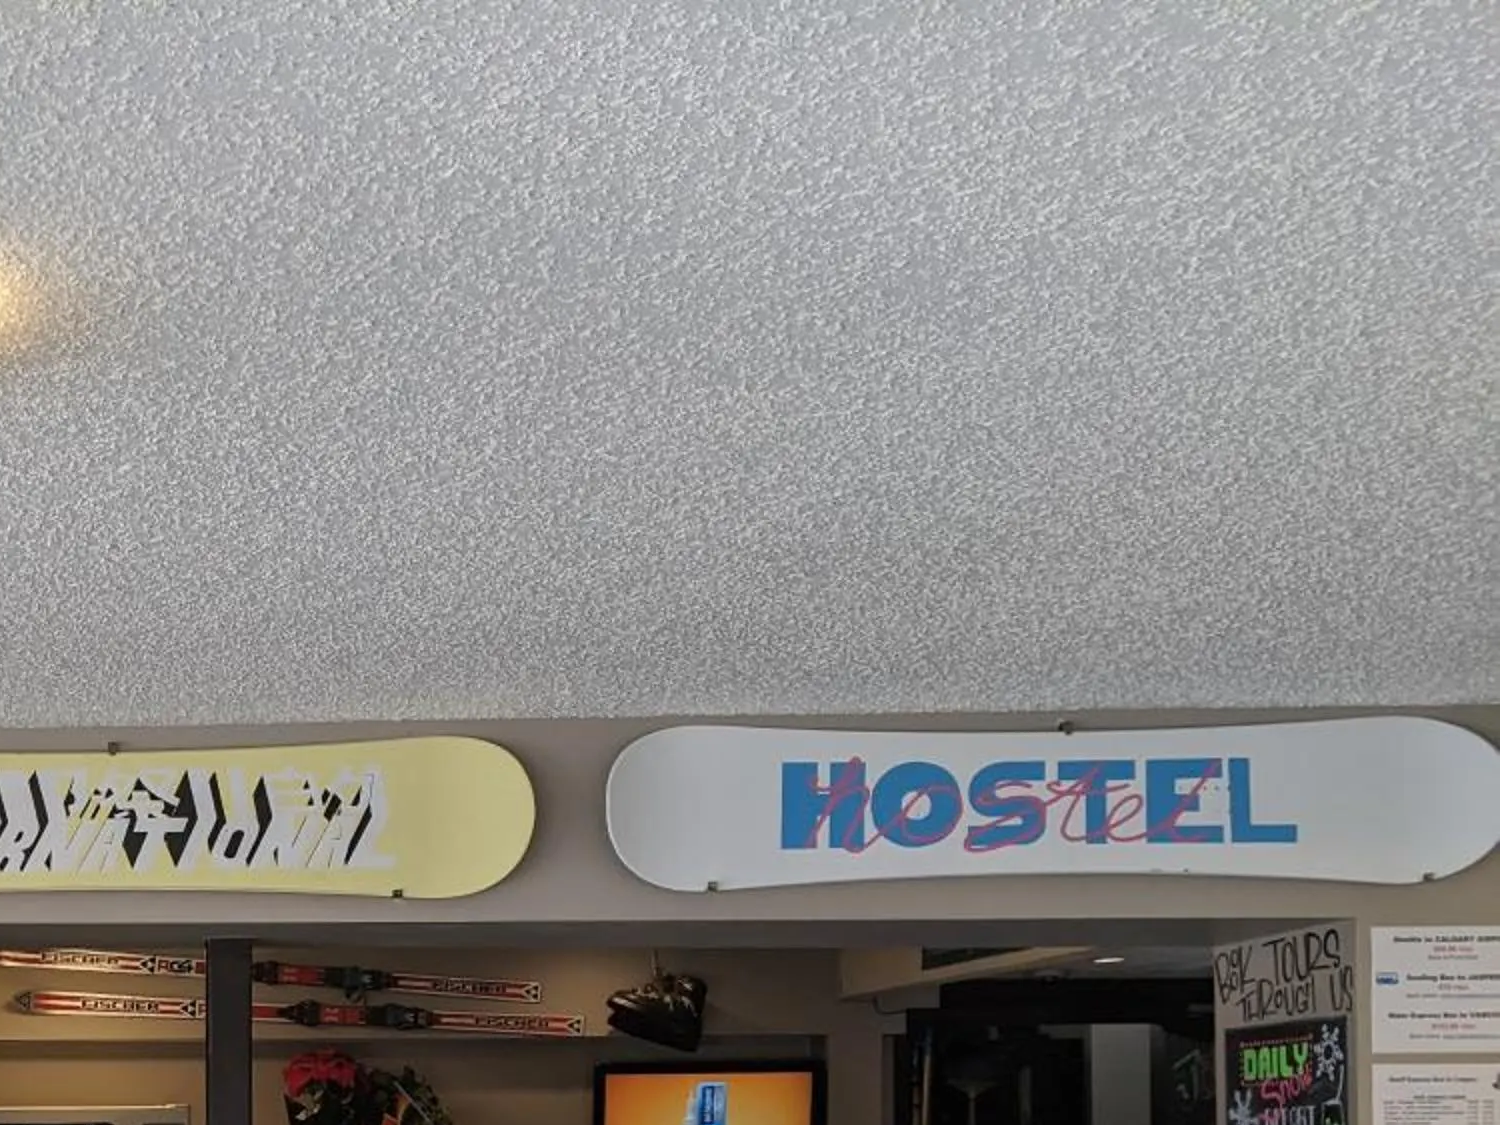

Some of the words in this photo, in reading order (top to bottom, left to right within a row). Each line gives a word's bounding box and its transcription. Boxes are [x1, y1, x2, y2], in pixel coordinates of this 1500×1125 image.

[780, 757, 1298, 851] HOSTEL
[41, 951, 119, 966] FISCHER
[1261, 928, 1341, 985] TOURS
[80, 998, 159, 1012] FISCHER
[1329, 965, 1353, 1012] US
[474, 1015, 549, 1030] FISCHER
[1243, 1042, 1309, 1081] DAILY
